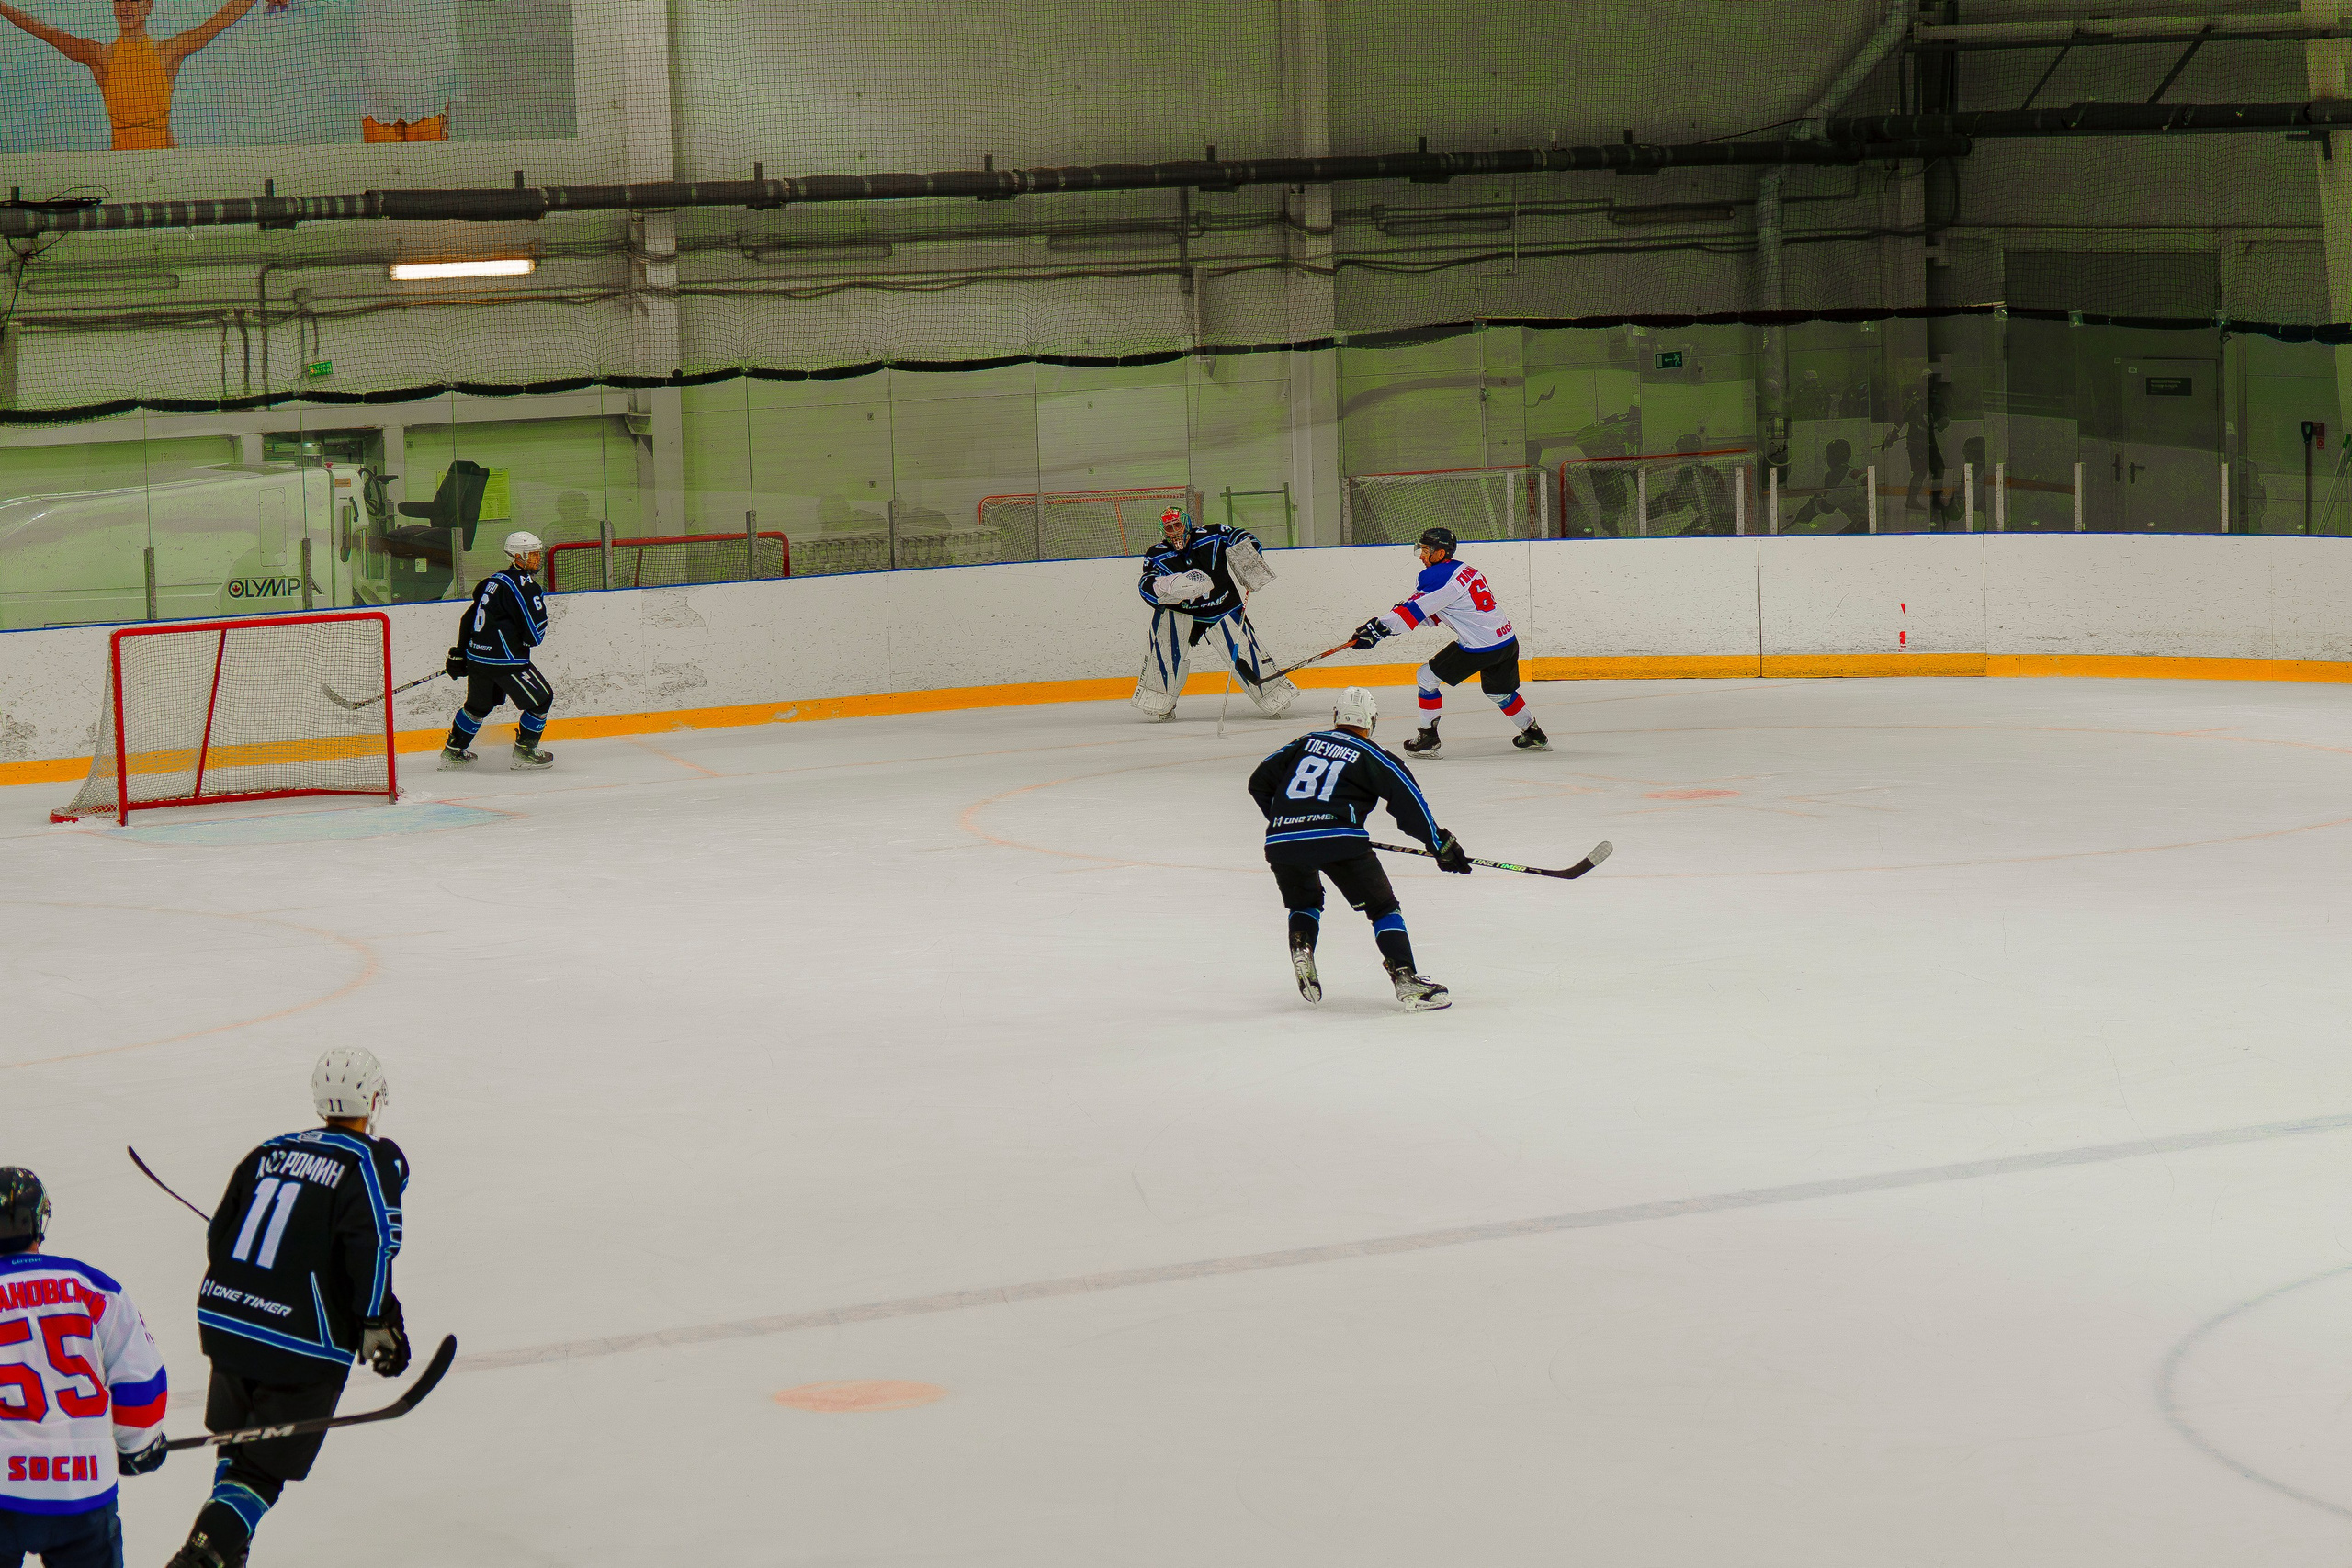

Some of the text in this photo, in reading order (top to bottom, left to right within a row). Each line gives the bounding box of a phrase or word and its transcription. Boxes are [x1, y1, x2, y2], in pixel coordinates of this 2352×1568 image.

[228, 578, 324, 598] OLYMPA
[473, 593, 490, 633] 6
[533, 595, 543, 611] 6
[1304, 738, 1361, 764] ТЛЕУЛИЕВ
[1286, 755, 1346, 802] 81
[1283, 816, 1306, 825] ONE
[329, 1098, 344, 1112] 11
[232, 1176, 303, 1269] 11
[212, 1285, 293, 1317] ONE TIMER
[0, 1313, 109, 1423] 55
[8, 1455, 98, 1481] SOCHI
